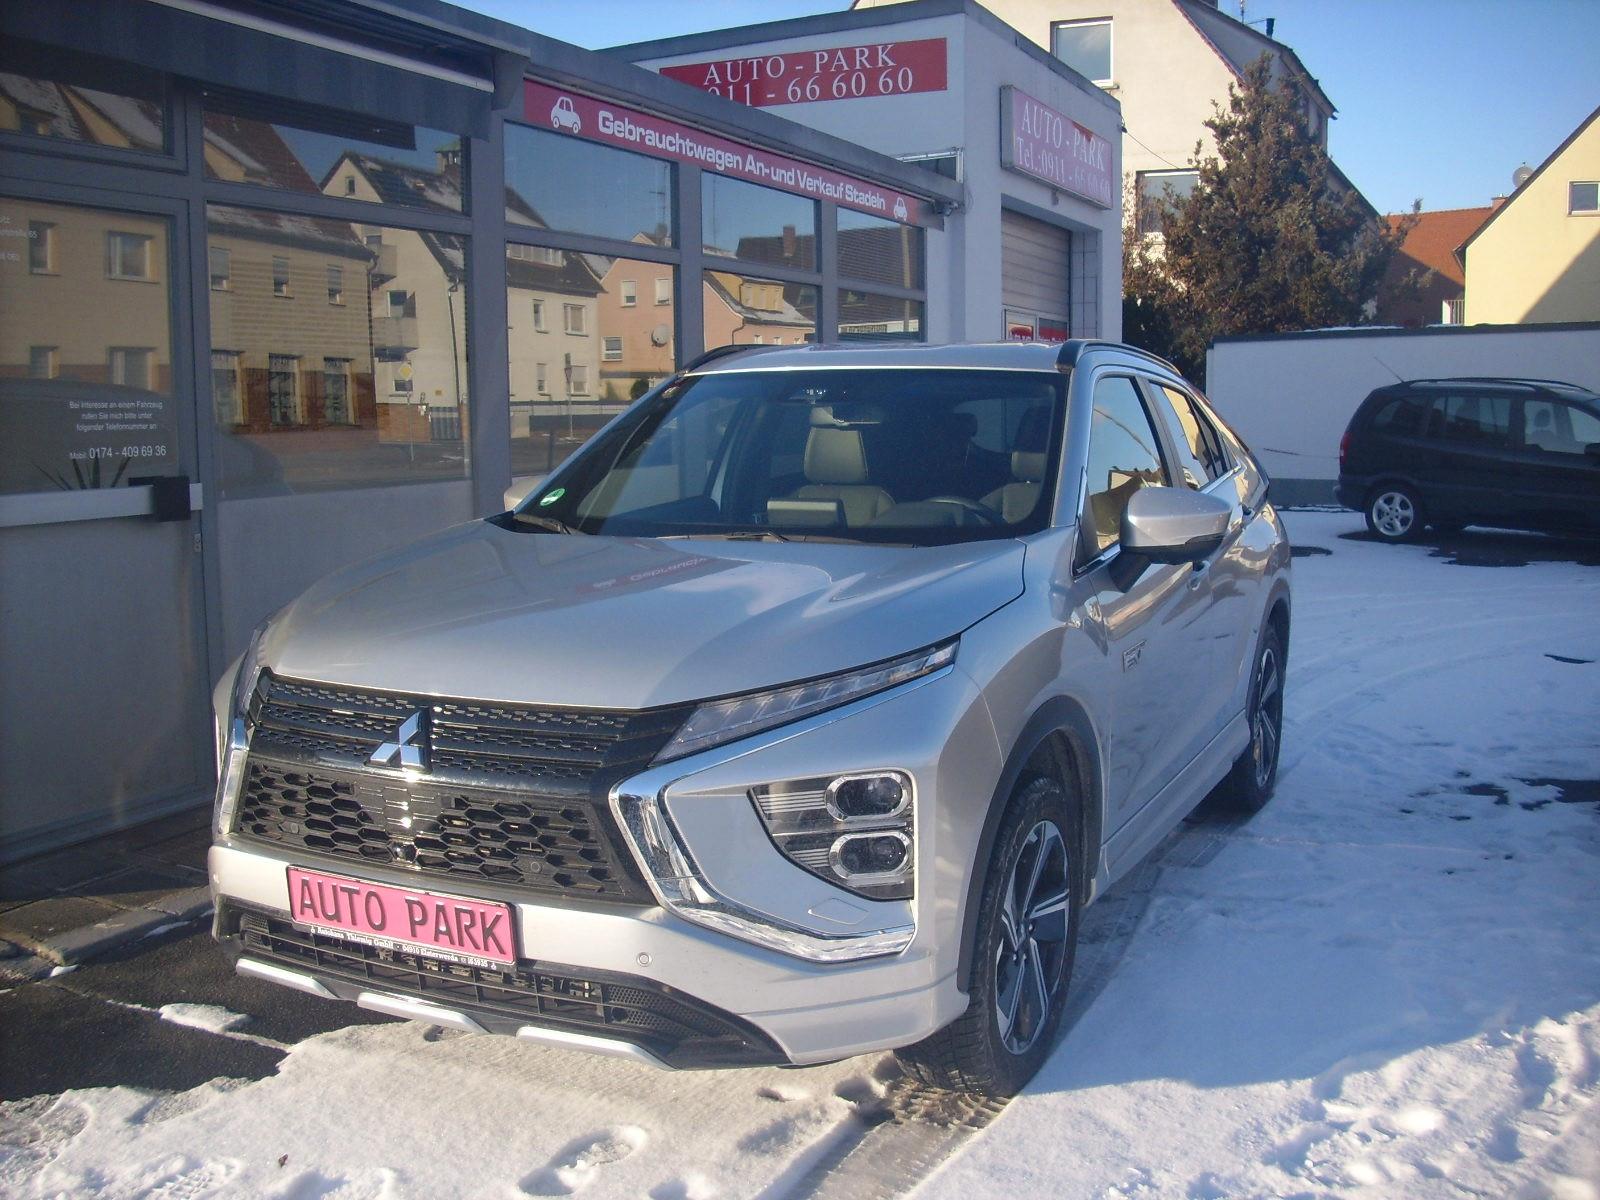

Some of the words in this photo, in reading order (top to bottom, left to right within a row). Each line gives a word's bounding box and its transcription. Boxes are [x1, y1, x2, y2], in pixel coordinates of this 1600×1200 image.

[703, 56, 785, 86] AUTO
[813, 44, 897, 74] PARK
[787, 76, 820, 103] 66
[832, 71, 866, 98] 60
[878, 67, 913, 92] 60
[1022, 100, 1062, 149] AUTO
[1073, 128, 1105, 172] PARK
[598, 110, 742, 171] Gebrauchtwagen
[797, 169, 844, 199] Verkauf
[845, 184, 886, 210] Stadeln
[136, 400, 163, 410] Fahrzeug
[89, 447, 113, 459] 0174
[121, 446, 139, 458] 409
[141, 446, 153, 457] 69
[155, 445, 167, 456] 36
[300, 876, 387, 931] AUTO
[404, 895, 506, 955] PARK
